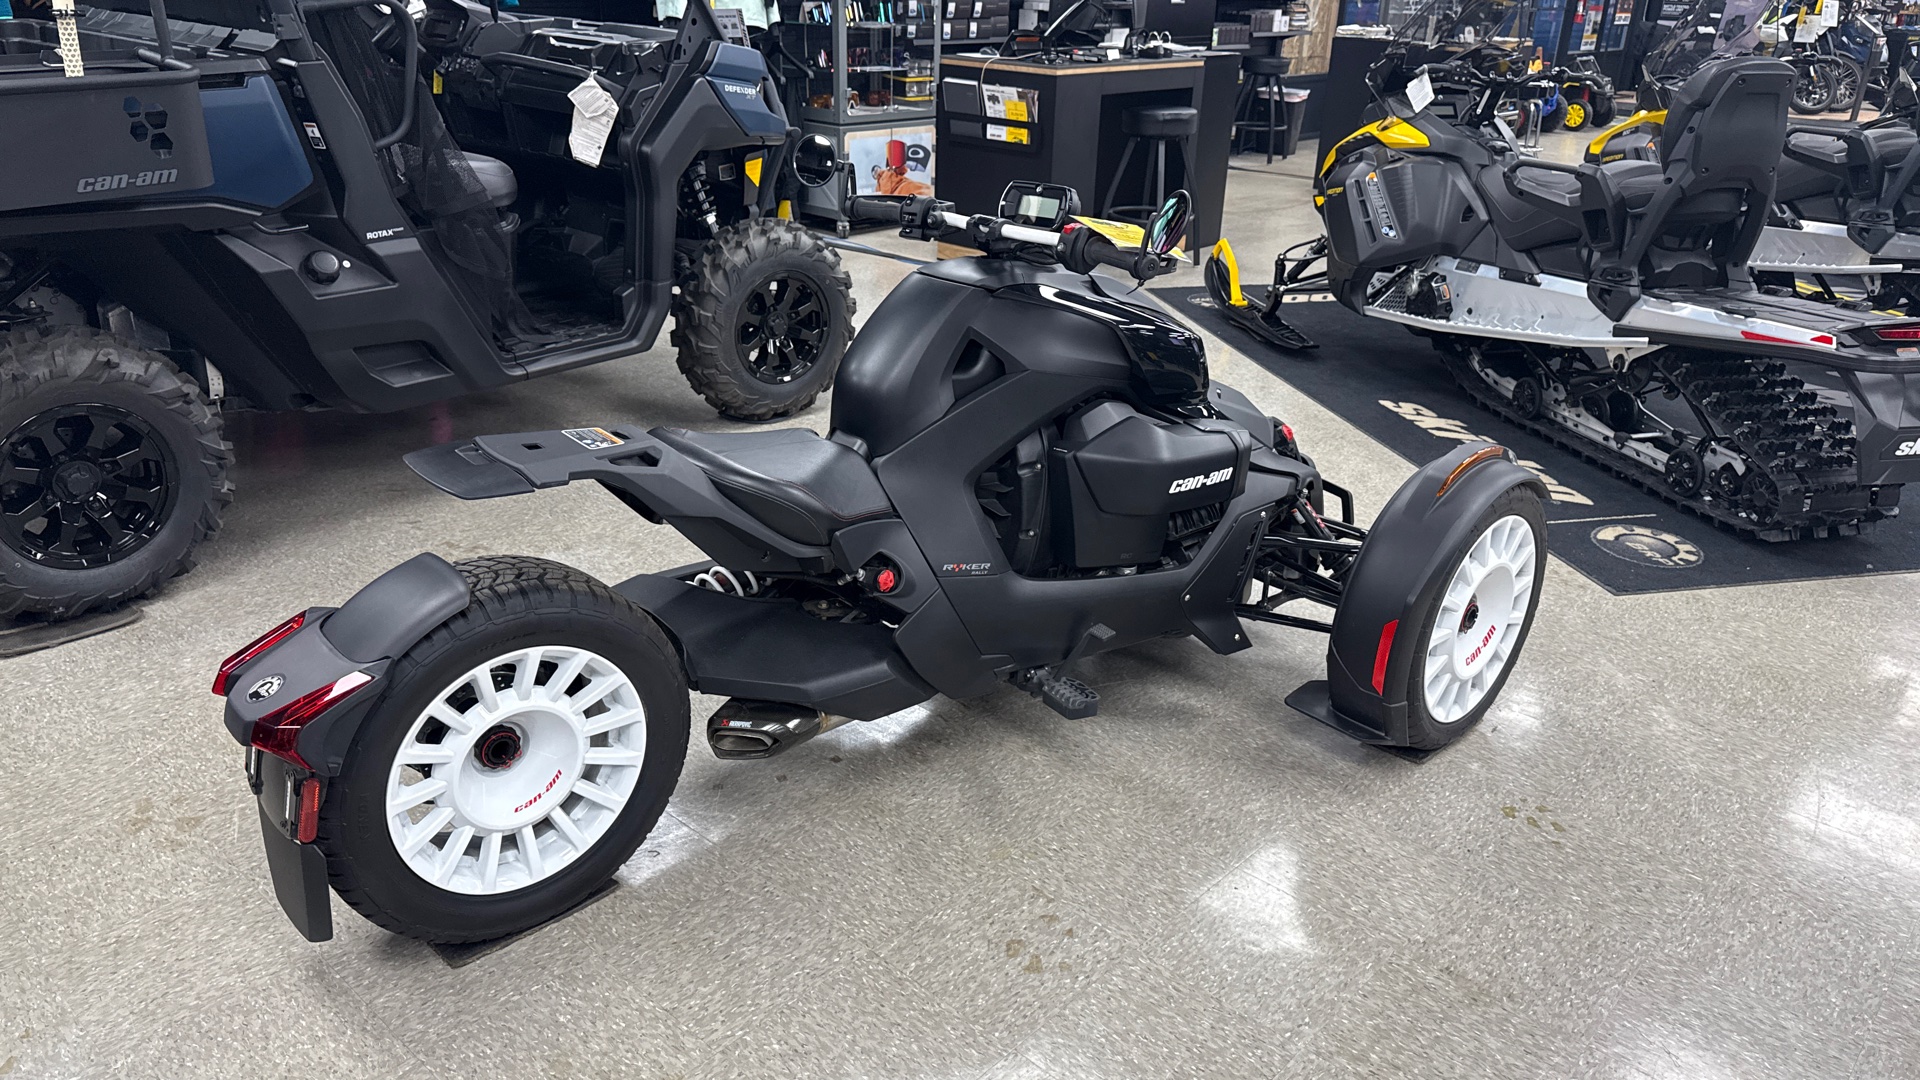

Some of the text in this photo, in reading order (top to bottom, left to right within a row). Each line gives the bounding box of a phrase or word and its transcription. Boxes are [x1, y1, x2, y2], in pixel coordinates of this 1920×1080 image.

[77, 168, 178, 193] can-am
[366, 229, 394, 240] ROTAX
[1168, 466, 1234, 494] can-am
[942, 563, 991, 573] RYKER
[1465, 624, 1496, 666] can-am
[514, 769, 562, 813] can-am
